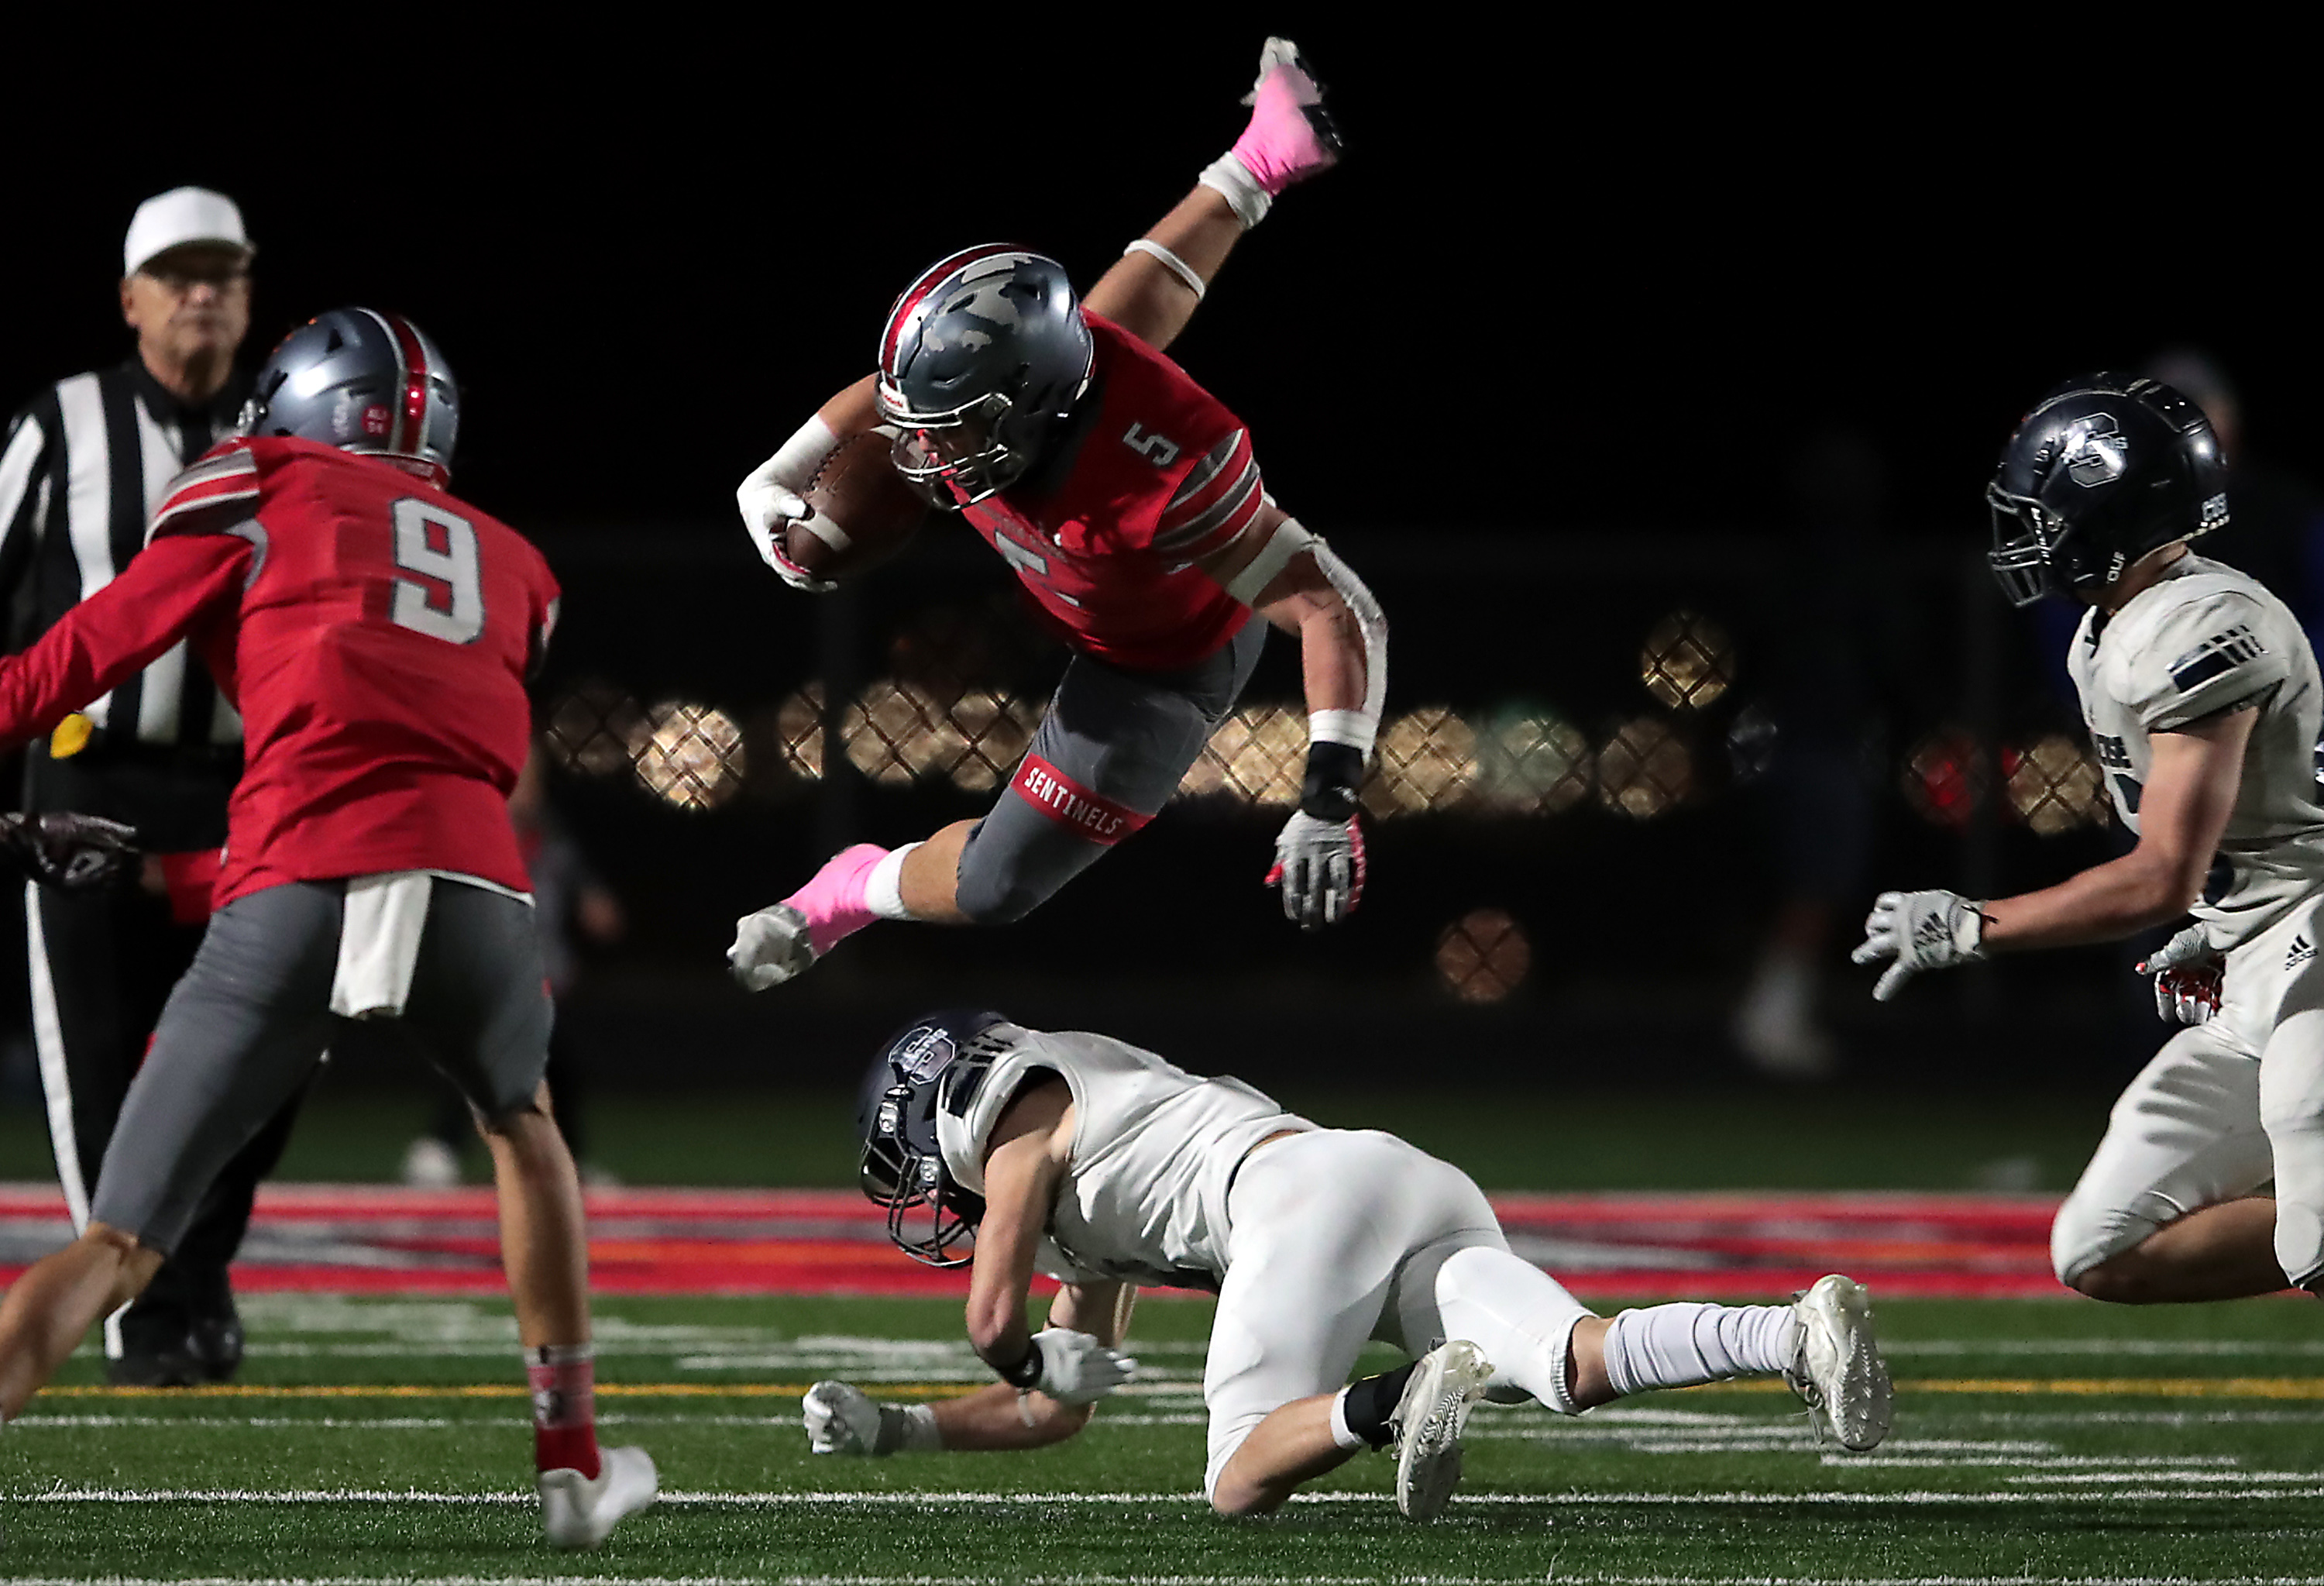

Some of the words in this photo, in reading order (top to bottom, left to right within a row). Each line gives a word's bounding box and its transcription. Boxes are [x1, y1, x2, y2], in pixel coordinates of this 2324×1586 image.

[1122, 421, 1178, 466] 5
[391, 497, 485, 645] 9
[1023, 766, 1123, 835] SENTINELS
